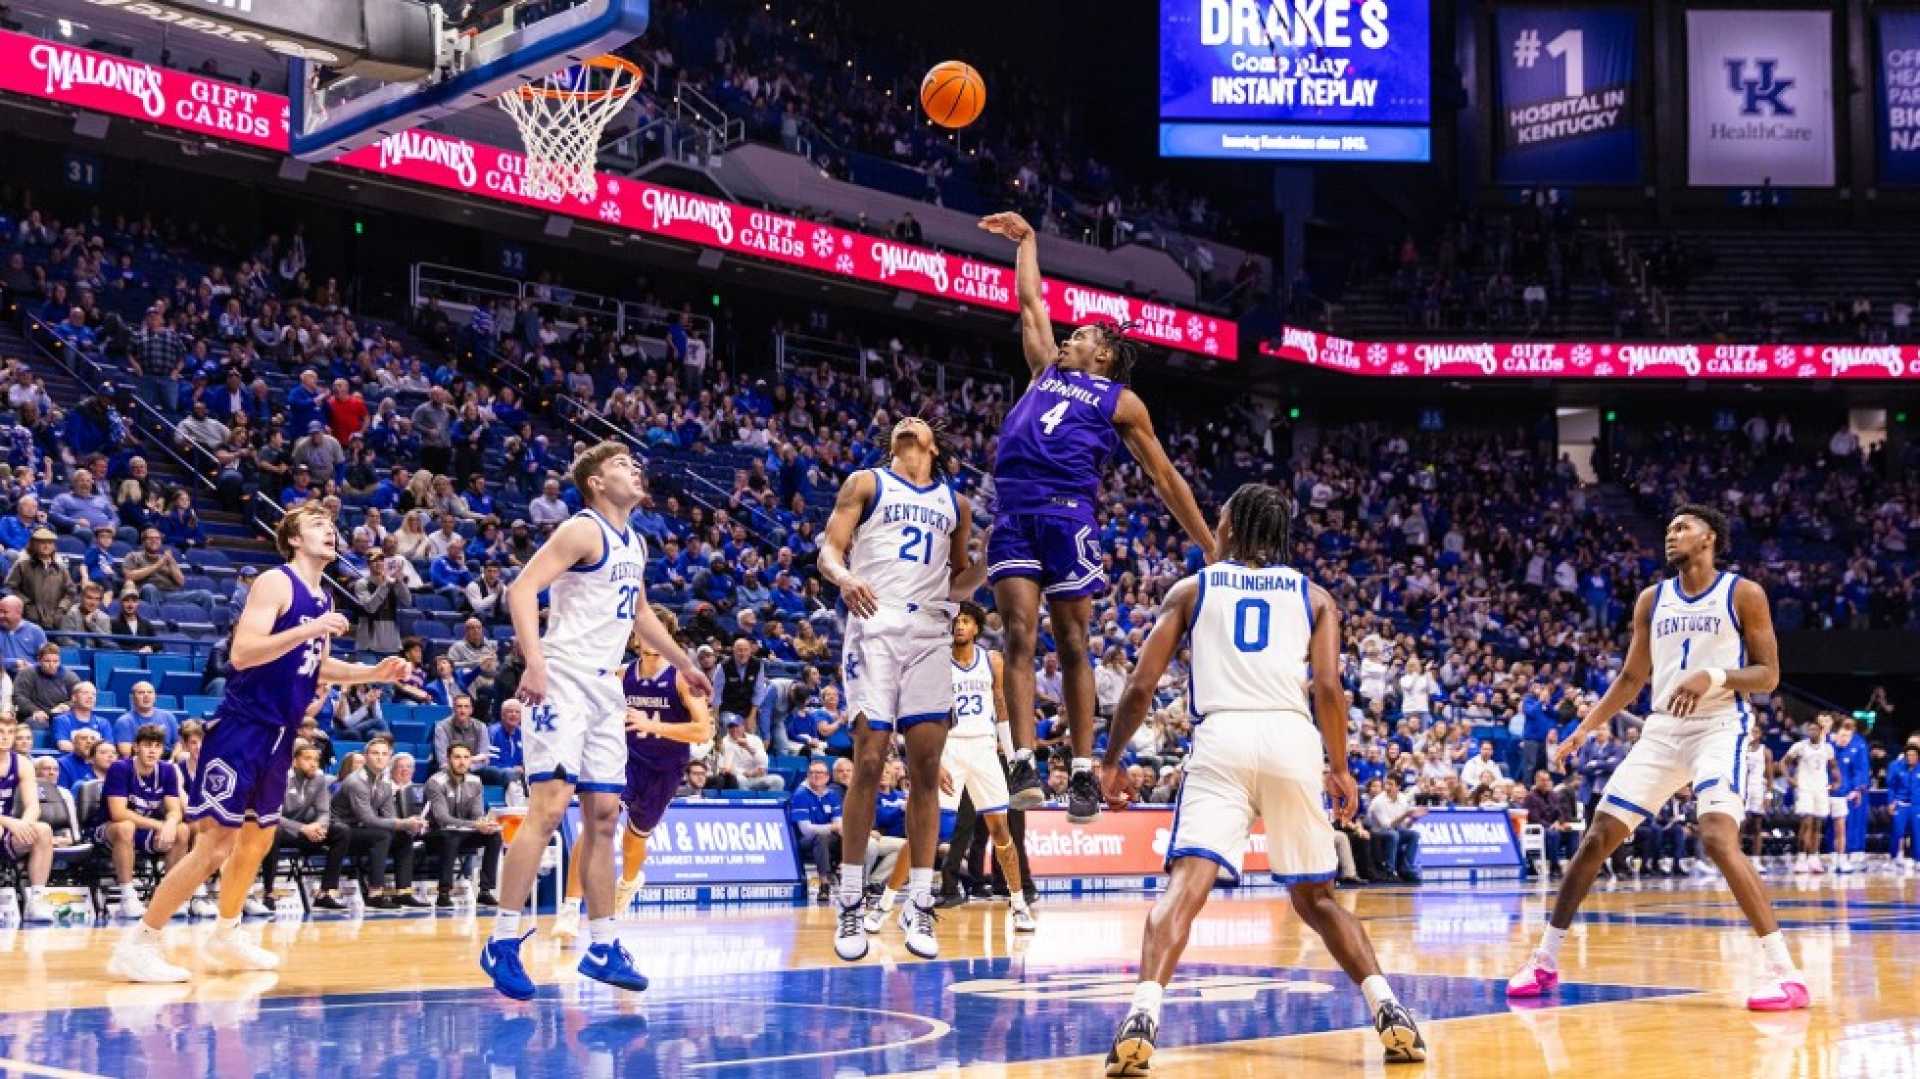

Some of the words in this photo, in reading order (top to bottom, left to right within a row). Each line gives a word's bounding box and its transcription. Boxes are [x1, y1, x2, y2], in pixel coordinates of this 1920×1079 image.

[1513, 28, 1583, 97] #1
[30, 44, 165, 117] MALONE'S
[1212, 77, 1297, 105] INSTANT
[1300, 78, 1378, 106] REPLAY
[1724, 58, 1795, 116] UK
[191, 81, 257, 113] GIFT
[1511, 95, 1601, 127] HOSPITAL
[1603, 89, 1624, 108] IN
[176, 101, 270, 137] CARDS
[1519, 109, 1619, 143] KENTUCKY
[1710, 122, 1813, 142] HealthCare
[69, 161, 93, 184] 31
[375, 131, 476, 187] MALONE'S
[642, 189, 733, 245] MALONE'S
[750, 212, 796, 238] GIFT
[740, 229, 804, 257] CARDS
[871, 242, 948, 292] MALONE'S
[961, 262, 1001, 285] GIFT
[953, 277, 1008, 303] CARDS
[1135, 318, 1182, 341] CARDS
[1142, 304, 1176, 327] GIFT
[1326, 337, 1353, 355] GIFT
[1512, 344, 1555, 358] GIFT
[1715, 345, 1759, 360] GIFT
[1503, 358, 1564, 371] CARDS
[1706, 358, 1767, 373] CARDS
[1040, 400, 1070, 435] 4
[884, 503, 950, 535] KENTUCKY
[899, 526, 933, 565] 21
[1211, 571, 1296, 592] DILLINGHAM
[1233, 598, 1270, 653] 0
[1656, 615, 1722, 639] KENTUCKY
[1680, 637, 1691, 670] 1
[951, 680, 991, 693] ENTUCKY
[957, 694, 982, 716] 23
[676, 822, 692, 852] &
[695, 822, 784, 851] MORGAN
